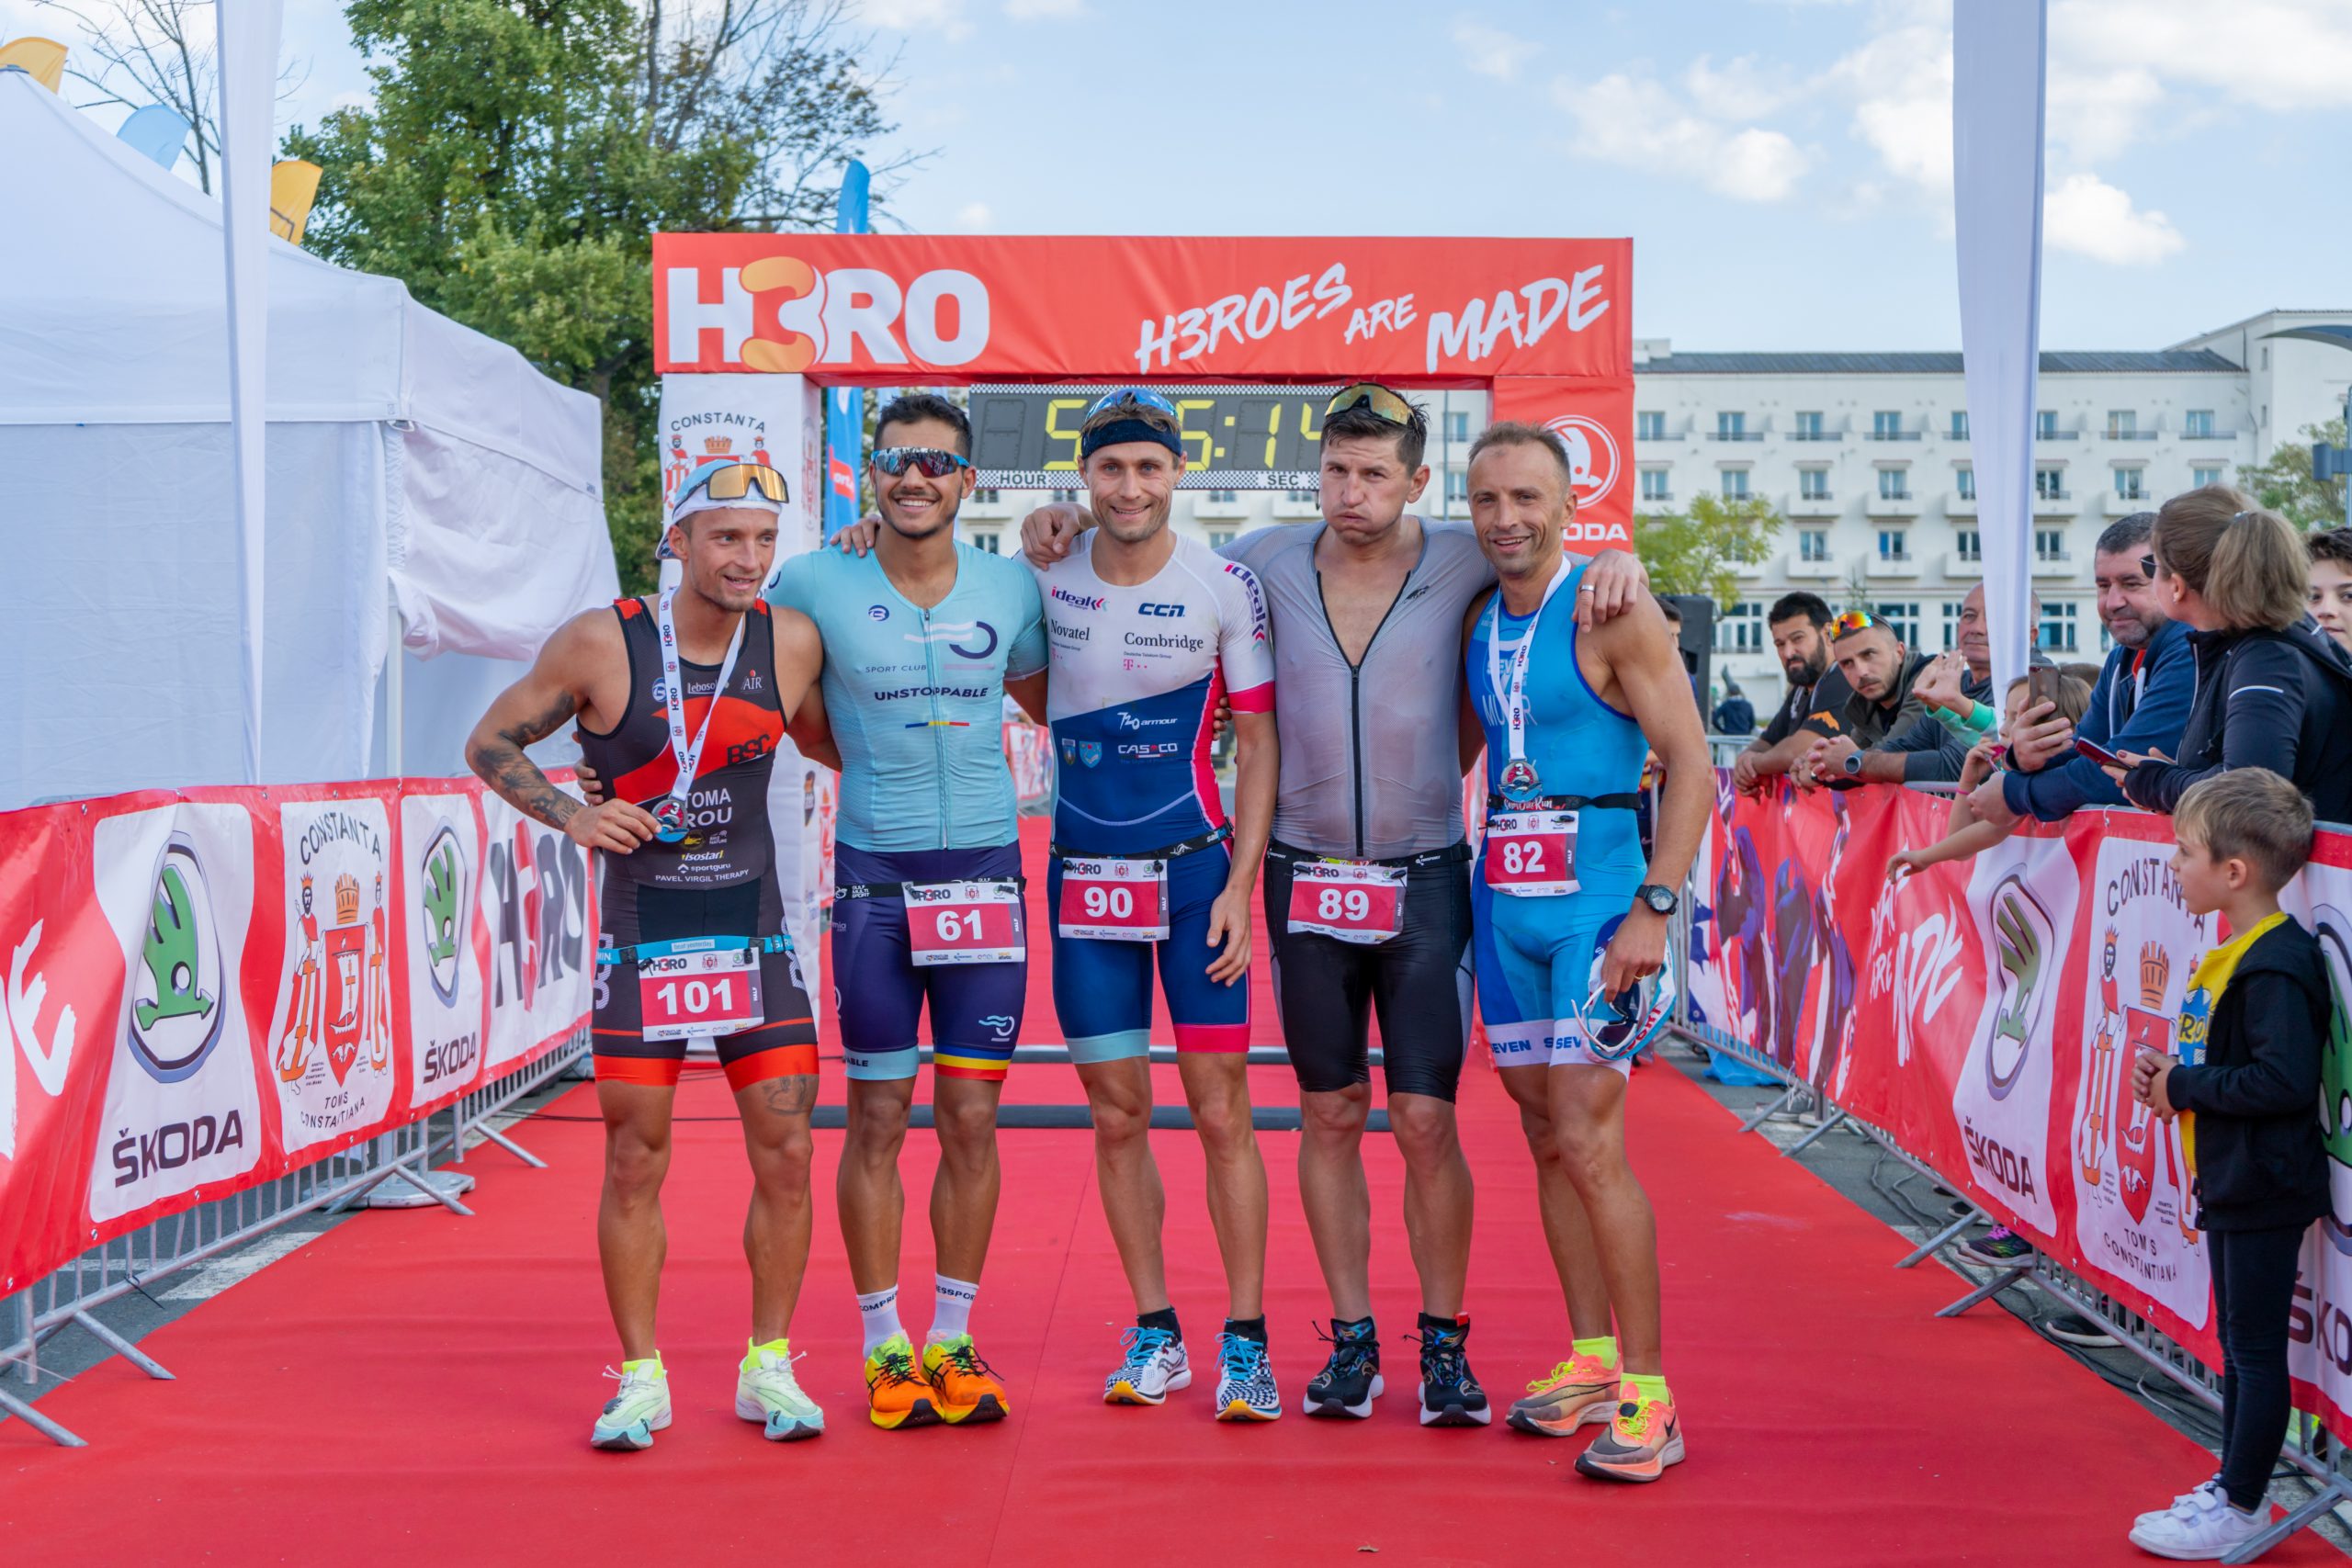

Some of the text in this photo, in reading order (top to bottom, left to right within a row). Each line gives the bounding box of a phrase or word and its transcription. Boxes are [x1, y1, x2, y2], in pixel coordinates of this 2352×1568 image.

[667, 255, 990, 372] H3RO
[1135, 262, 1610, 375] H3ROES ARE MADE
[670, 412, 765, 434] CONSTANTA
[999, 473, 1300, 488] HOUR SEC
[1562, 523, 1629, 542] ODA
[662, 624, 674, 648] H3RO
[1050, 618, 1091, 641] Novatel
[1124, 631, 1204, 653] Combridge
[1517, 645, 1528, 668] H3RO
[865, 664, 927, 673] SPORT CLUB
[742, 676, 763, 691] AIR
[874, 686, 989, 701] UNSTOPPABLE
[672, 686, 680, 711] H3RO
[1140, 717, 1178, 726] armour
[1512, 706, 1521, 730] H3RO
[685, 787, 732, 809] TOMA
[687, 807, 733, 828] ROU
[1497, 818, 1518, 832] H3RO
[300, 811, 382, 866] CONSTANTA
[684, 850, 724, 862] isostar
[1503, 840, 1546, 874] 82
[655, 874, 683, 883] PAVEL
[715, 869, 750, 882] THERAPY
[690, 863, 731, 873] sportguru
[1073, 863, 1102, 875] H3RO
[1307, 865, 1340, 878] H3RO
[919, 888, 951, 902] H3RO
[1084, 886, 1134, 919] 90
[1317, 887, 1370, 922] 89
[2107, 857, 2206, 943] CONSTANA
[935, 909, 983, 942] 61
[652, 957, 688, 972] H3RO
[656, 977, 733, 1016] 101
[422, 1031, 476, 1085] ŠKODA
[111, 1108, 243, 1188] ŠKODA
[1964, 1115, 2038, 1206] ŠKODA
[2103, 1232, 2177, 1283] CONSTANTIANA
